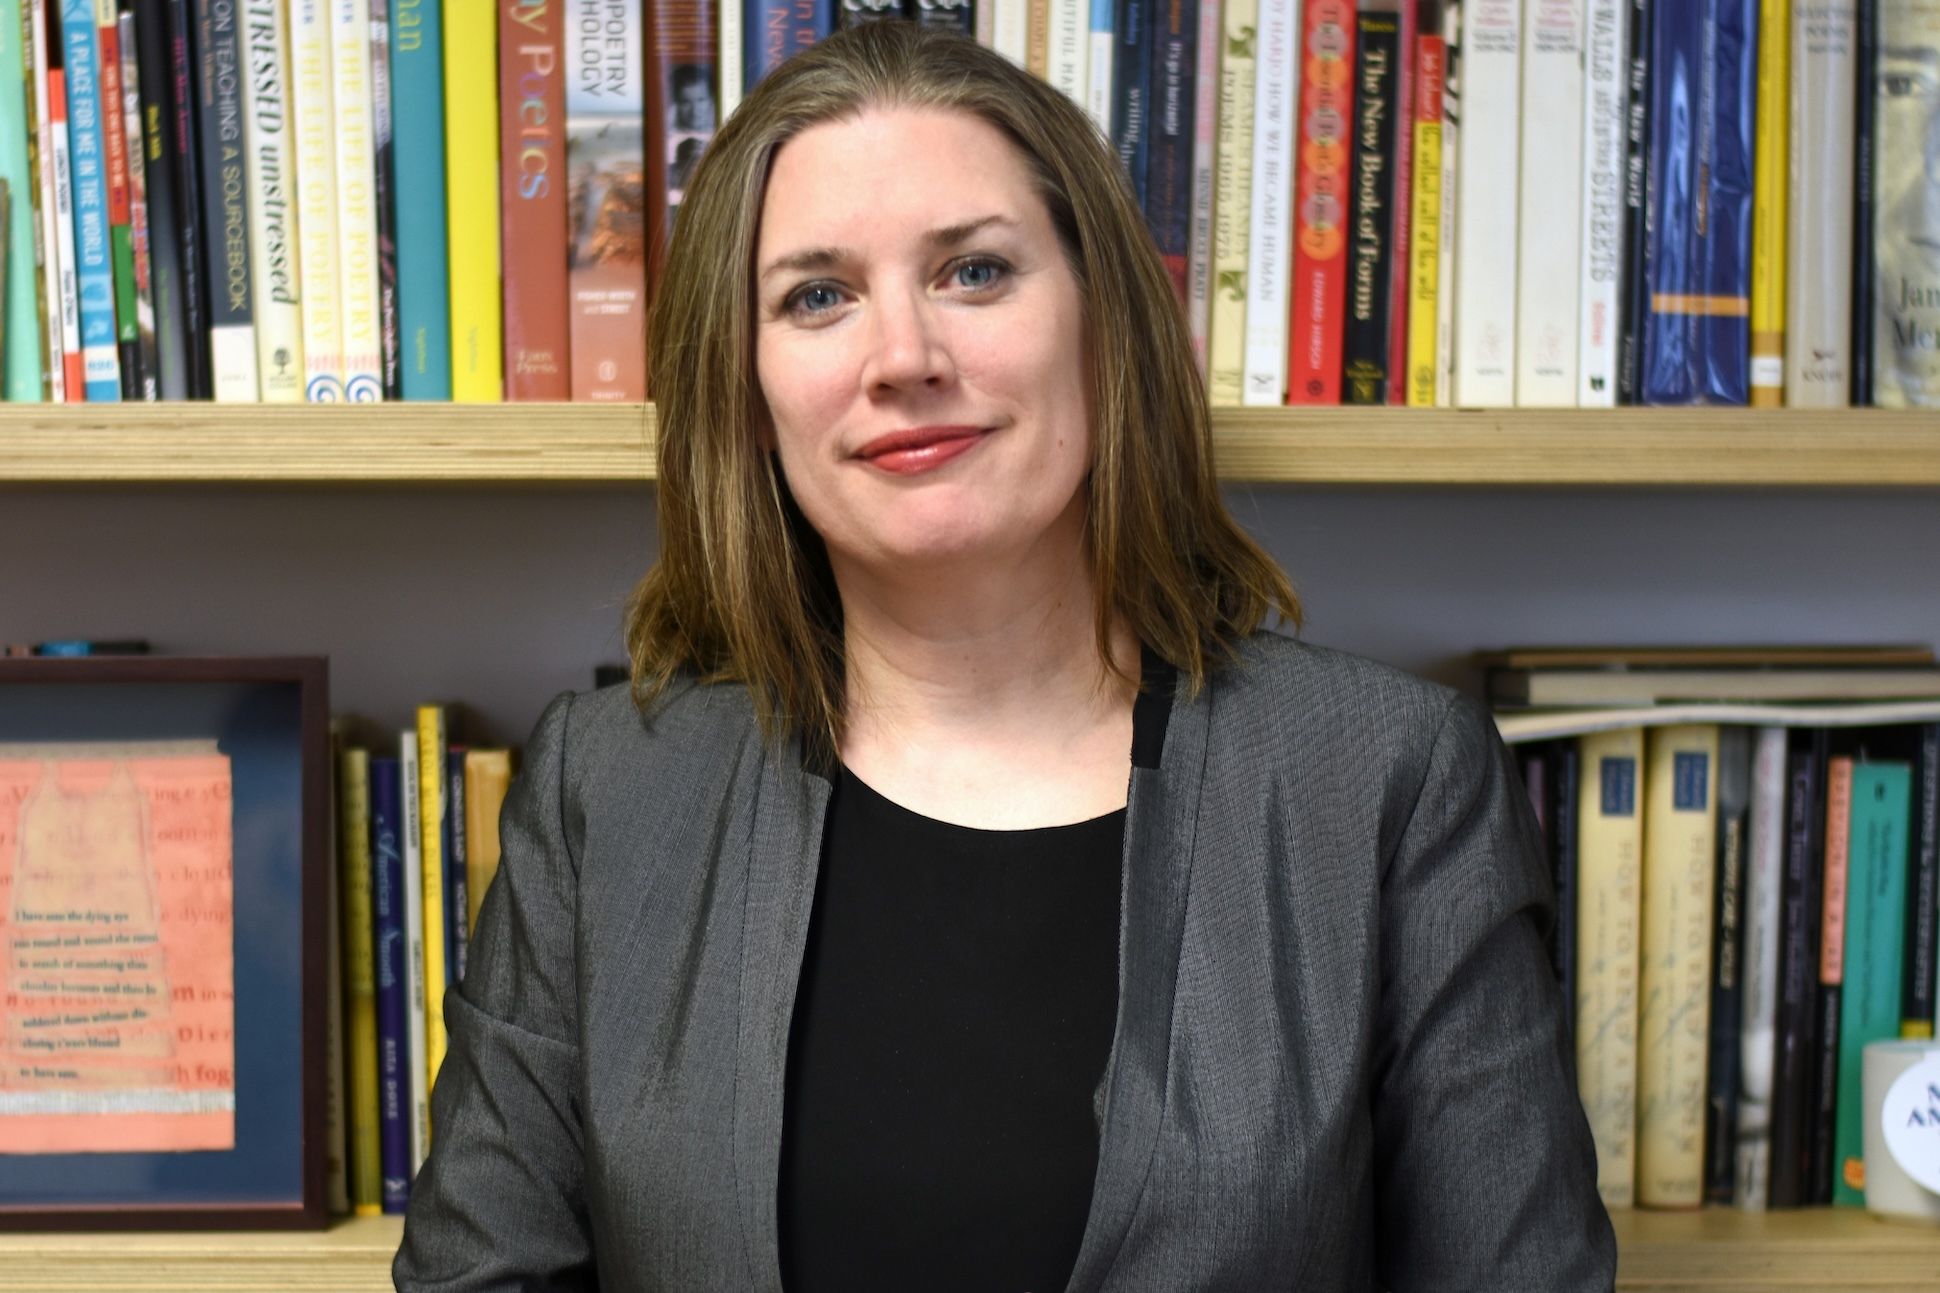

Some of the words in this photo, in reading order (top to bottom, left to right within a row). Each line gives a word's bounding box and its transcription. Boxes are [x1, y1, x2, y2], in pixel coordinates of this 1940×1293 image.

[69, 33, 87, 43] A
[506, 0, 549, 34] y
[1322, 6, 1338, 36] The
[71, 46, 92, 96] PLACE
[300, 36, 323, 94] THE
[339, 36, 363, 94] THE
[605, 0, 628, 97] POETRY
[1268, 20, 1285, 78] HARJO
[1361, 49, 1387, 94] The
[215, 35, 239, 142] TEACHING
[1319, 43, 1338, 118] Essential
[1631, 57, 1647, 92] The
[74, 98, 95, 130] FOR
[517, 44, 556, 200] Poetics
[1123, 87, 1143, 144] writing
[1165, 85, 1182, 136] horizontal
[1221, 69, 1238, 145] POEMS
[1266, 81, 1283, 125] HOW
[1361, 98, 1385, 150] New
[1630, 103, 1646, 144] New
[77, 131, 97, 156] ME
[221, 144, 240, 162] A
[302, 103, 325, 171] LIFE
[341, 103, 367, 171] LIFE
[1266, 129, 1281, 156] WE
[1317, 123, 1333, 171] Poet's
[79, 159, 97, 176] IN
[80, 179, 98, 207] THE
[1263, 159, 1280, 227] BECAME
[1359, 153, 1383, 213] Book
[1627, 155, 1644, 208] World
[256, 145, 298, 306] unstressed
[306, 181, 328, 221] OF
[345, 180, 367, 221] OF
[1307, 175, 1332, 250] Glossary
[82, 211, 104, 267] WORLD
[221, 165, 247, 313] SOURCEBOOK
[1358, 217, 1380, 246] of
[308, 232, 333, 345] POETRY
[346, 231, 373, 345] POETRY
[1193, 262, 1208, 300] PRATT
[1260, 234, 1276, 302] HUMAN
[1353, 246, 1379, 321] Forms
[1311, 271, 1325, 322] EDWARD
[1310, 323, 1324, 370] HIRSCH
[376, 829, 401, 916] American
[385, 1038, 397, 1074] RITA
[386, 1079, 398, 1120] DOVE
